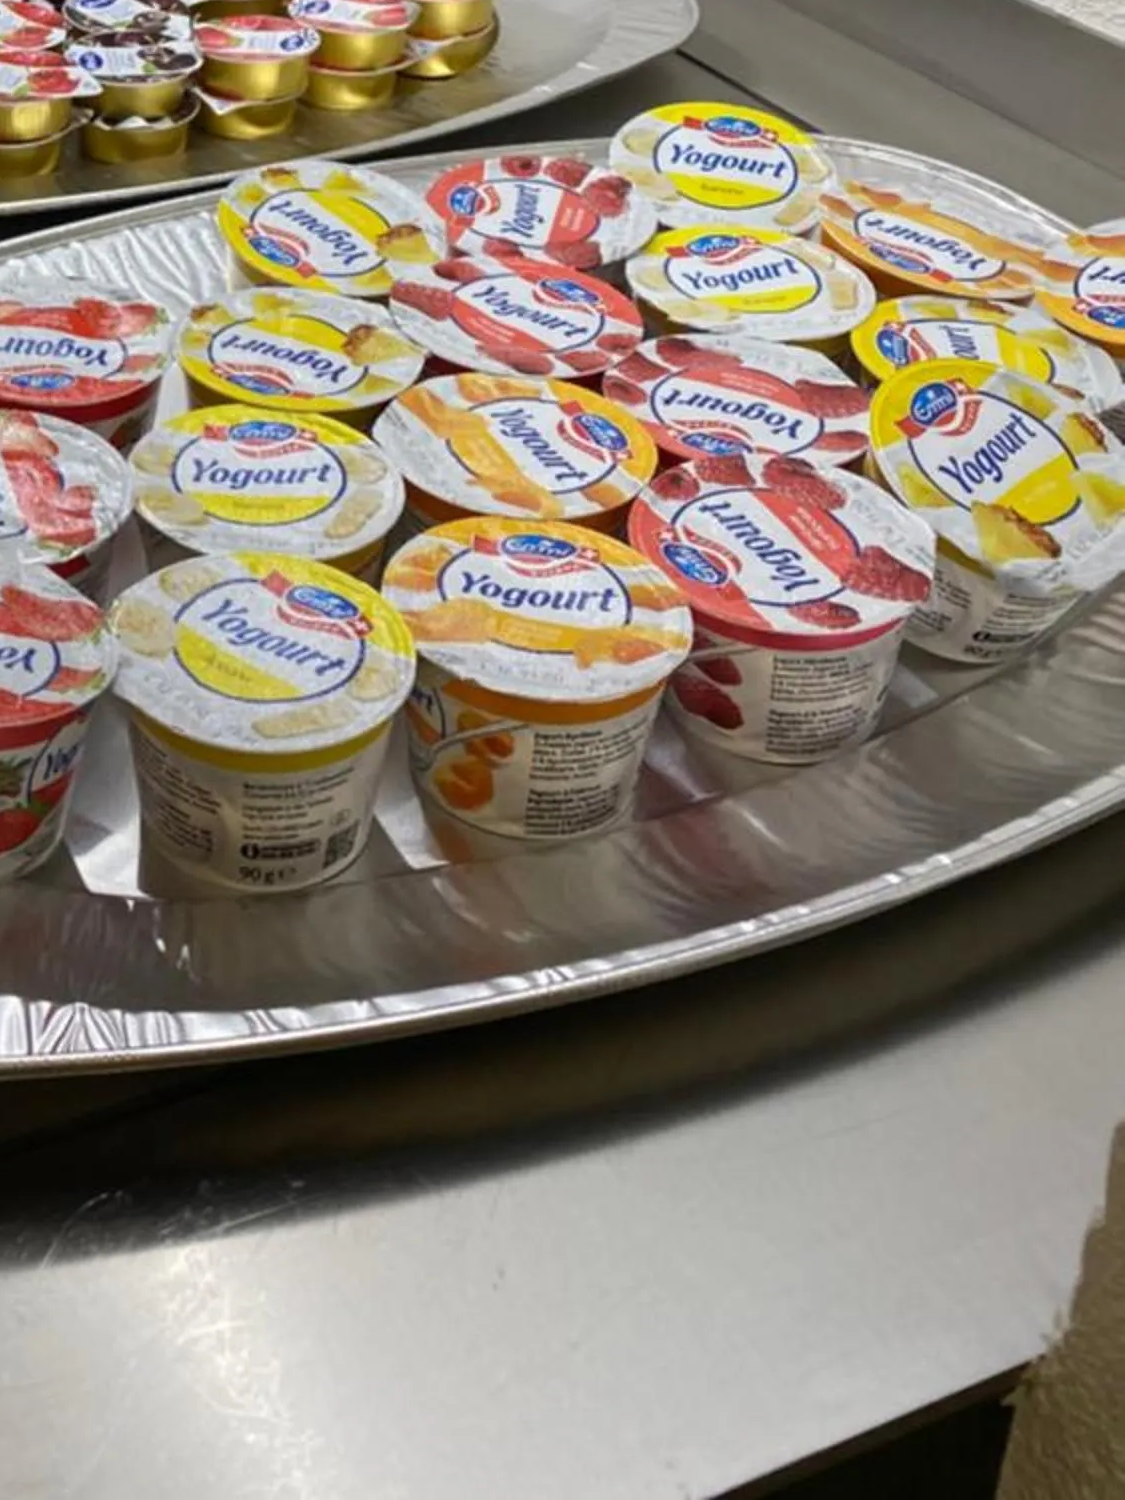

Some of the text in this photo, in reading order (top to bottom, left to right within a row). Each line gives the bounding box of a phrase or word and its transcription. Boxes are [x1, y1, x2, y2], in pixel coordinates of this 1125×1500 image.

[670, 143, 788, 178] Yogourt
[268, 200, 369, 266] Yogourt
[866, 217, 986, 271] Yogourt
[681, 257, 799, 291] Yogourt
[472, 285, 589, 338] Yogourt
[221, 333, 348, 383] Yogourt
[661, 388, 804, 440] Yogourt
[491, 407, 588, 482] Yogourt
[939, 411, 1037, 495] Yogourt
[192, 457, 333, 489] Yogourt
[699, 502, 820, 592] Yogourt
[460, 571, 618, 613] Yogourt
[202, 598, 348, 676] Yogourt
